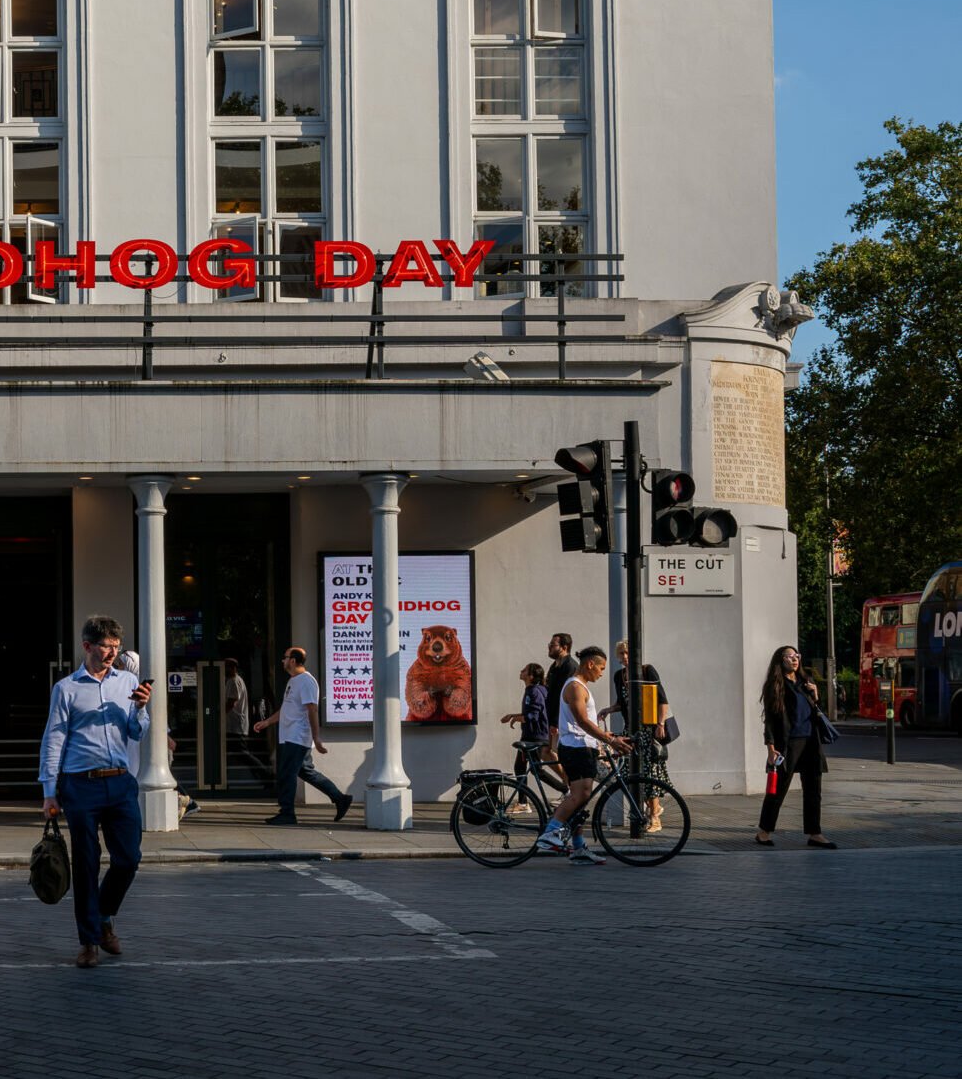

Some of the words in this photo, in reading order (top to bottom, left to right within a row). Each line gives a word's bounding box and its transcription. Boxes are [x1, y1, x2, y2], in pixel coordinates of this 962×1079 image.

[315, 238, 497, 289] DAY
[332, 564, 354, 575] AT
[658, 559, 686, 569] THE
[695, 559, 724, 570] CUT
[332, 576, 368, 587] OLD
[658, 575, 685, 586] SE1
[332, 592, 365, 600] ANDY
[332, 601, 461, 611] GRODHOG
[332, 613, 369, 624] DAY
[332, 630, 371, 639] DANNY
[333, 644, 353, 652] TIM
[333, 678, 366, 686] Olivier
